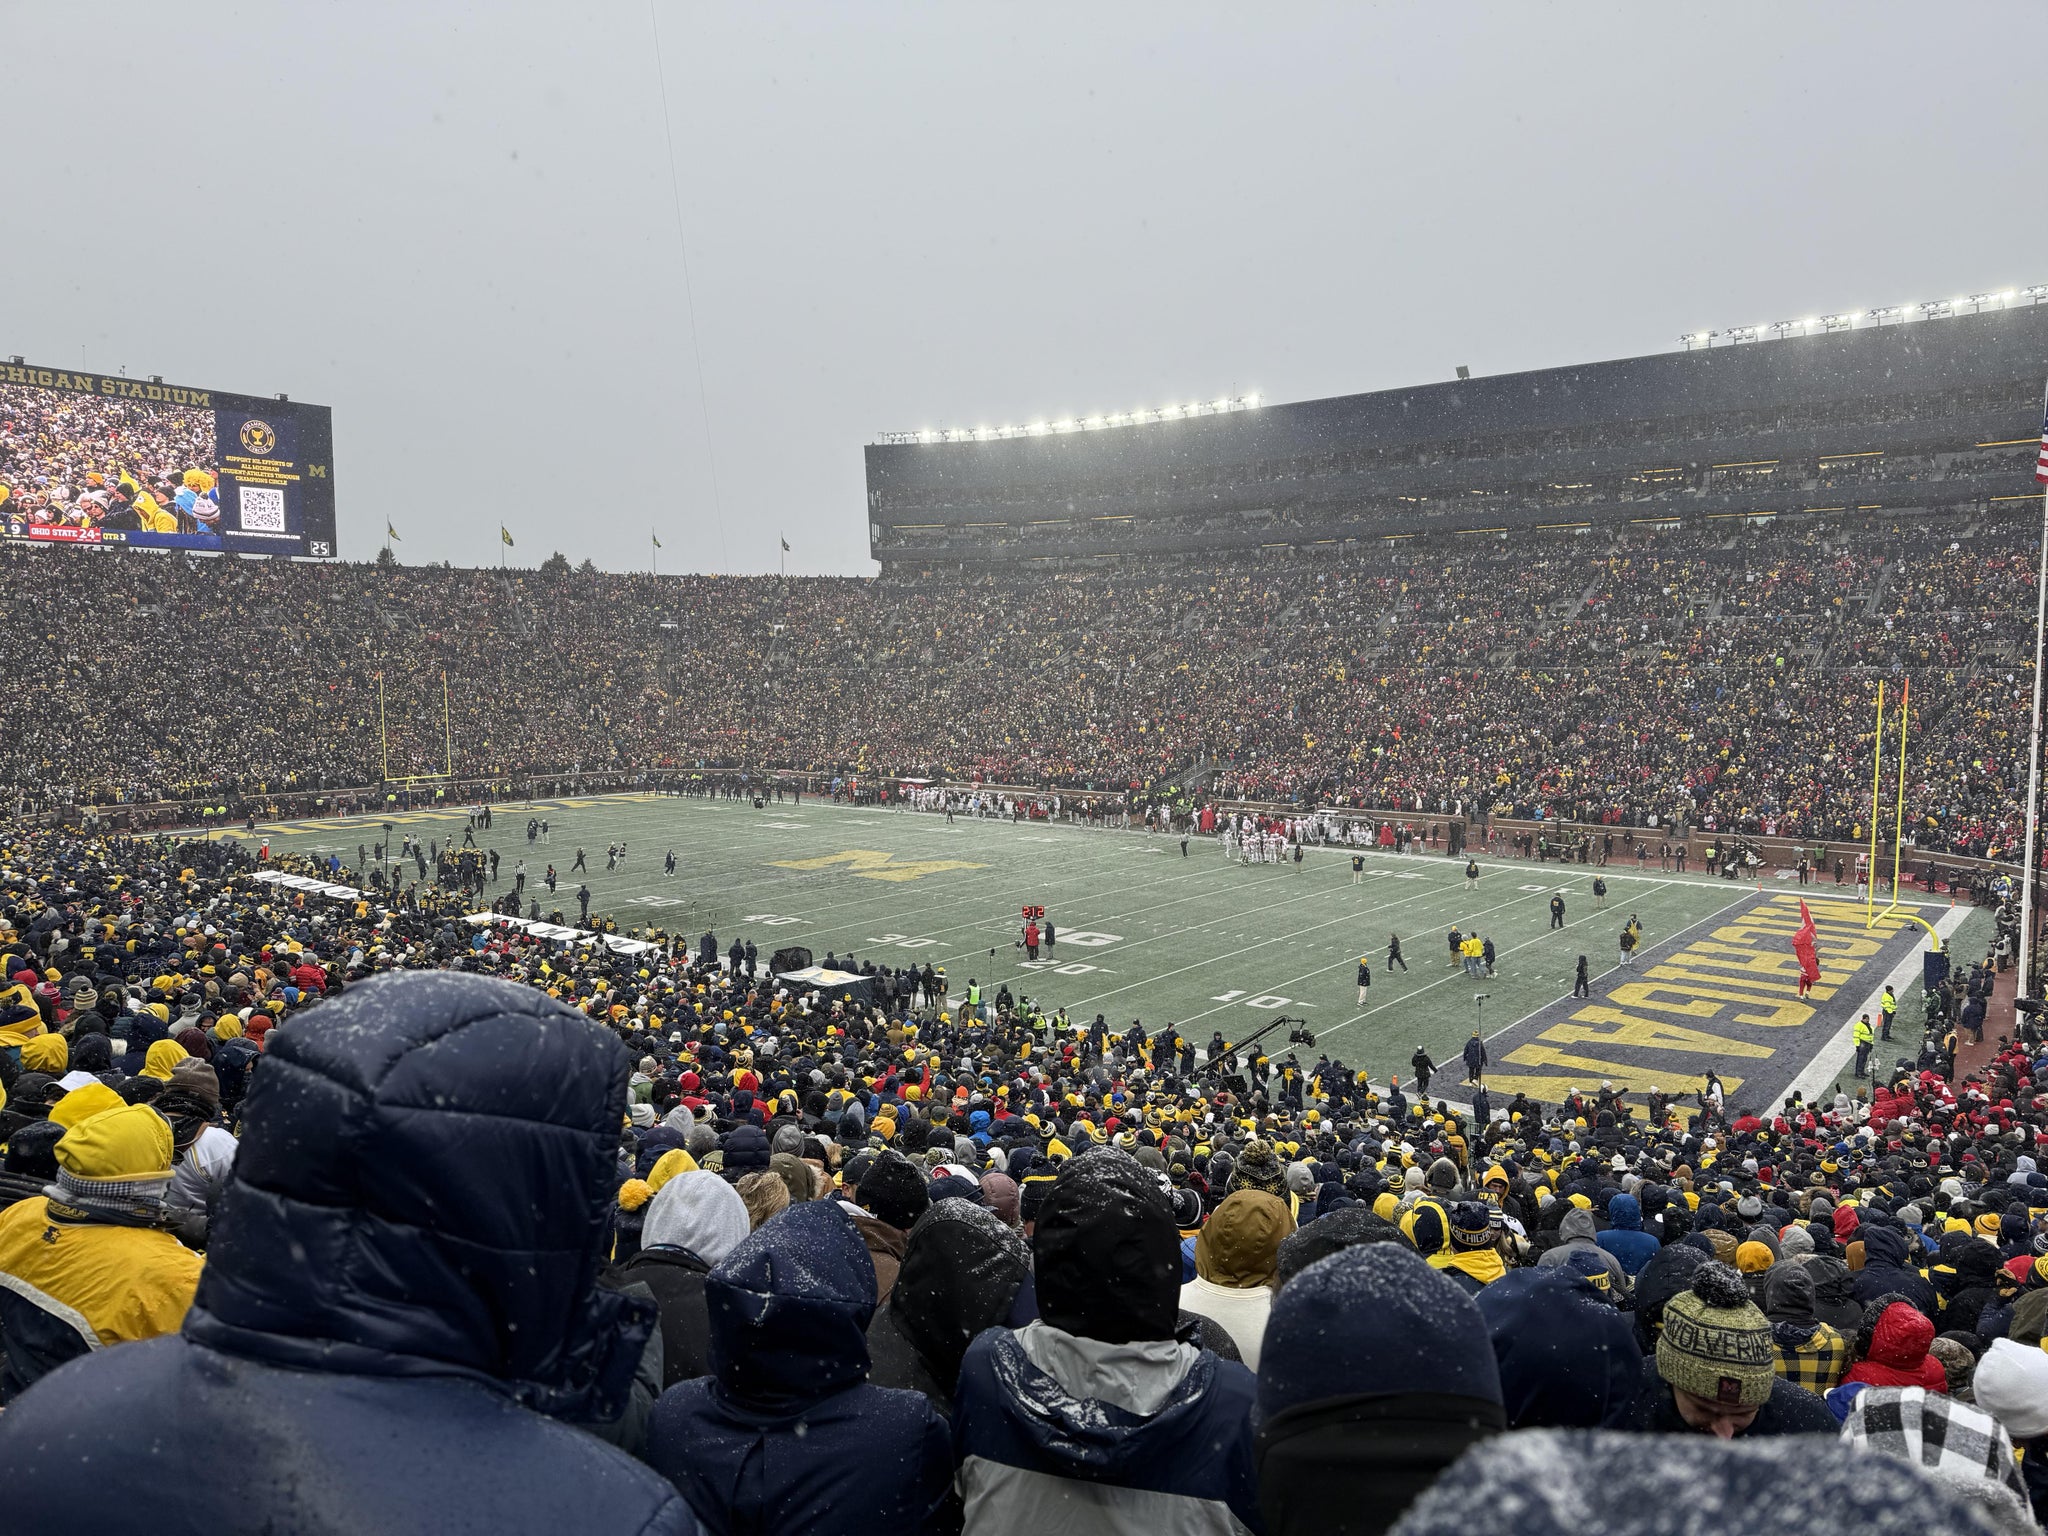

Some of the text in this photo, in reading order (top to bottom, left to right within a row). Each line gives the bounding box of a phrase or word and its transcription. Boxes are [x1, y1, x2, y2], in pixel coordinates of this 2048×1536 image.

[101, 379, 210, 407] STADIUM
[308, 464, 326, 478] M
[11, 524, 20, 534] 9
[31, 527, 50, 535] OHIO
[52, 529, 78, 537] STATE
[312, 543, 328, 554] 25
[763, 849, 991, 882] M
[866, 934, 938, 948] 30
[1210, 990, 1293, 1009] 10
[1460, 895, 1919, 1133] MICHIGAN
[1942, 1086, 1953, 1097] 4
[1452, 1225, 1491, 1243] MICHIGAN
